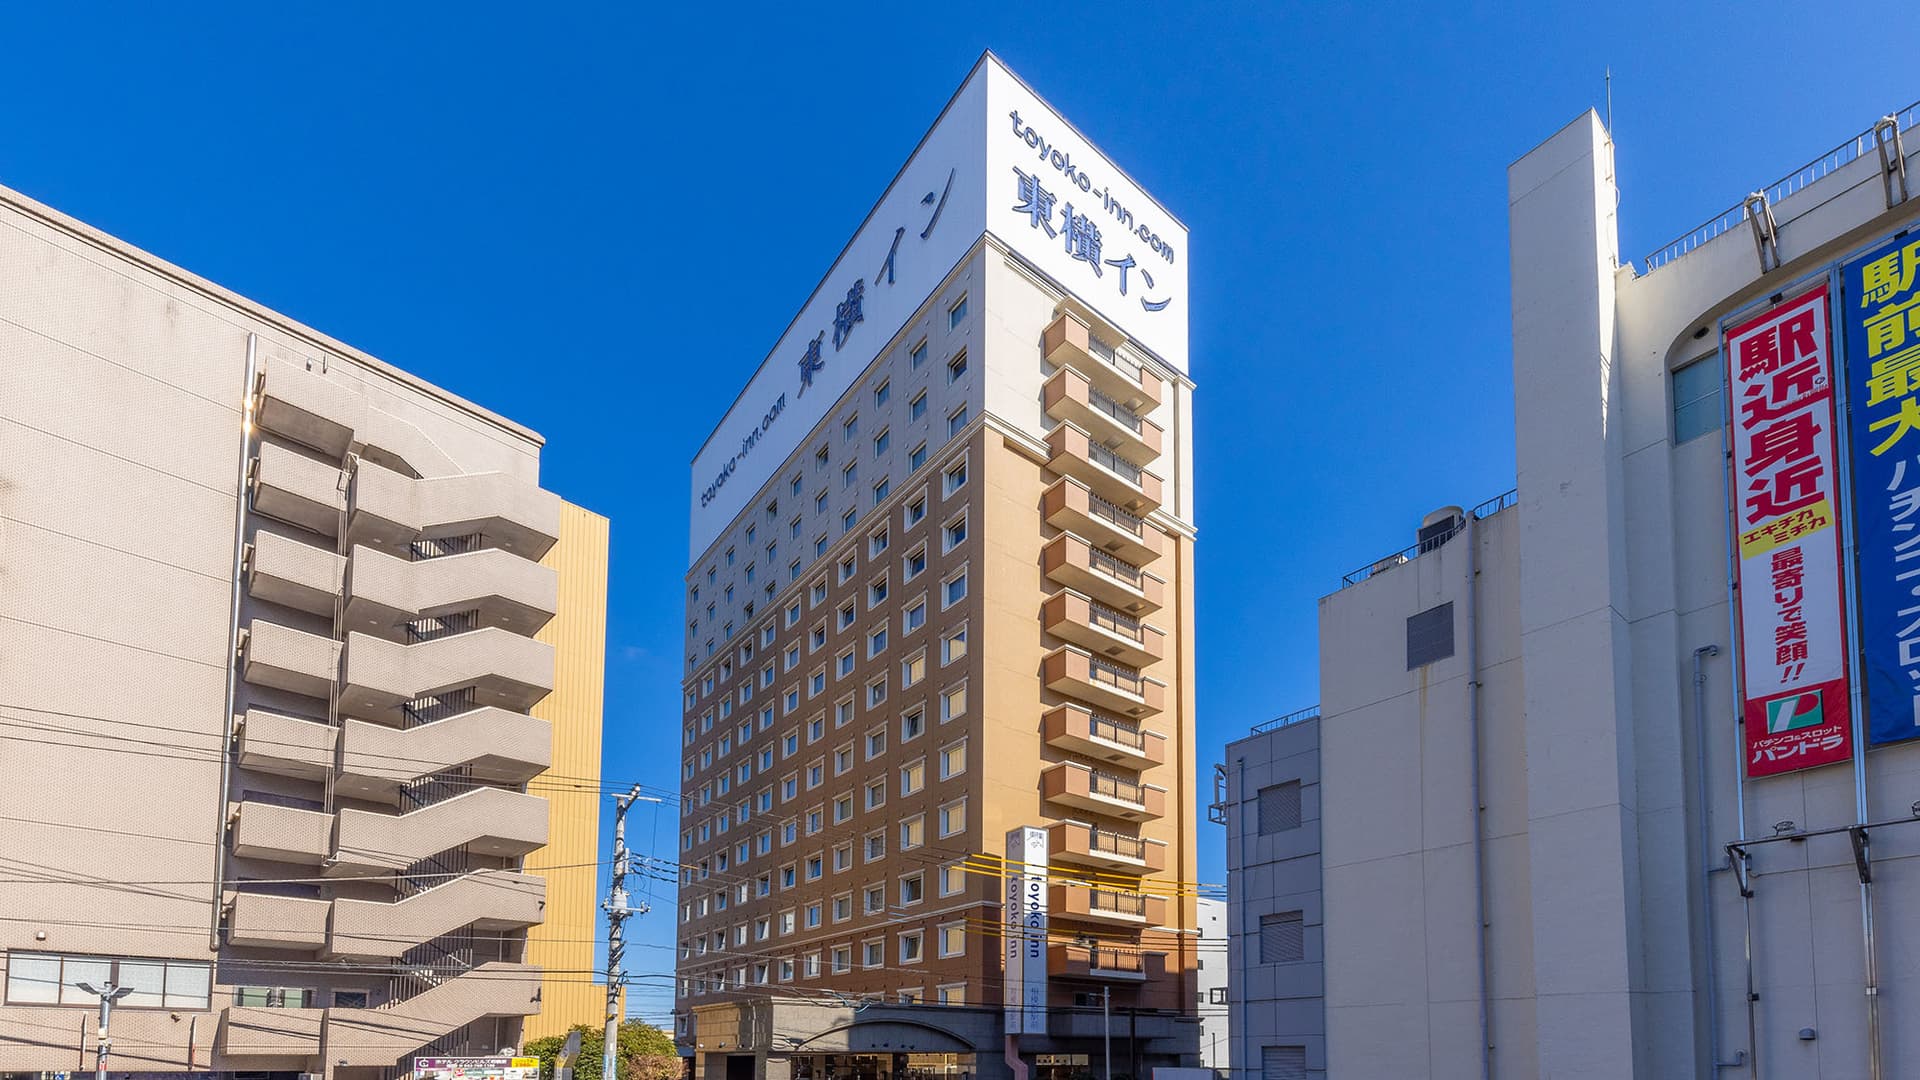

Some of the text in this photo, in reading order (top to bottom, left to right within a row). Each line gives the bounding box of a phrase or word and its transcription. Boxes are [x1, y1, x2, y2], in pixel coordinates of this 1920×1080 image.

[1009, 110, 1174, 264] toyoko-inn.com
[1012, 166, 1171, 312] 東横イン
[798, 168, 956, 399] 東横イン
[701, 393, 786, 507] toyoko-inn.com
[1740, 309, 1827, 524] 駅近身近
[1744, 509, 1814, 545] エキチカ
[1752, 734, 1844, 764] パンドラ
[1009, 876, 1019, 958] toyoko inn
[1028, 876, 1042, 958] toyoko inn
